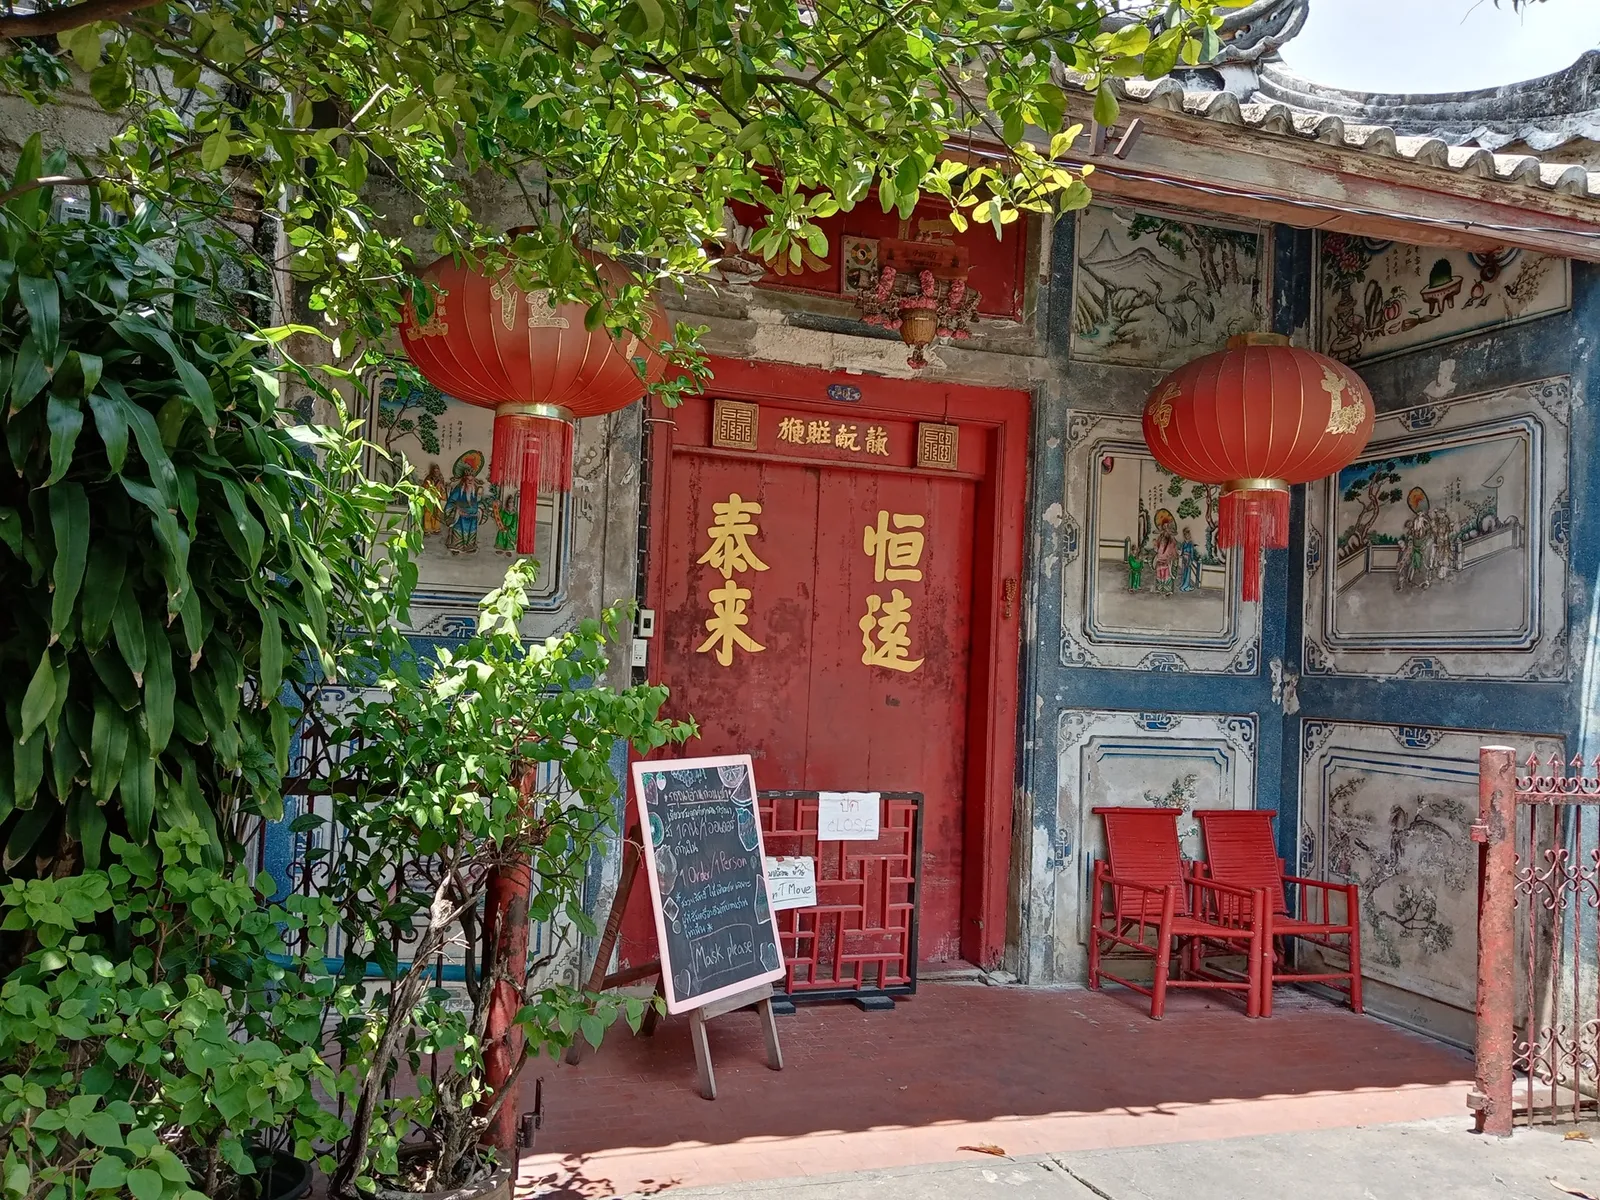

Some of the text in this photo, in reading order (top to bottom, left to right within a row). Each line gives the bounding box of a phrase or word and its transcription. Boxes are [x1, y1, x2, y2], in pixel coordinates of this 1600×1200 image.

[826, 818, 875, 833] CLOSE
[695, 933, 753, 972] Mask please
